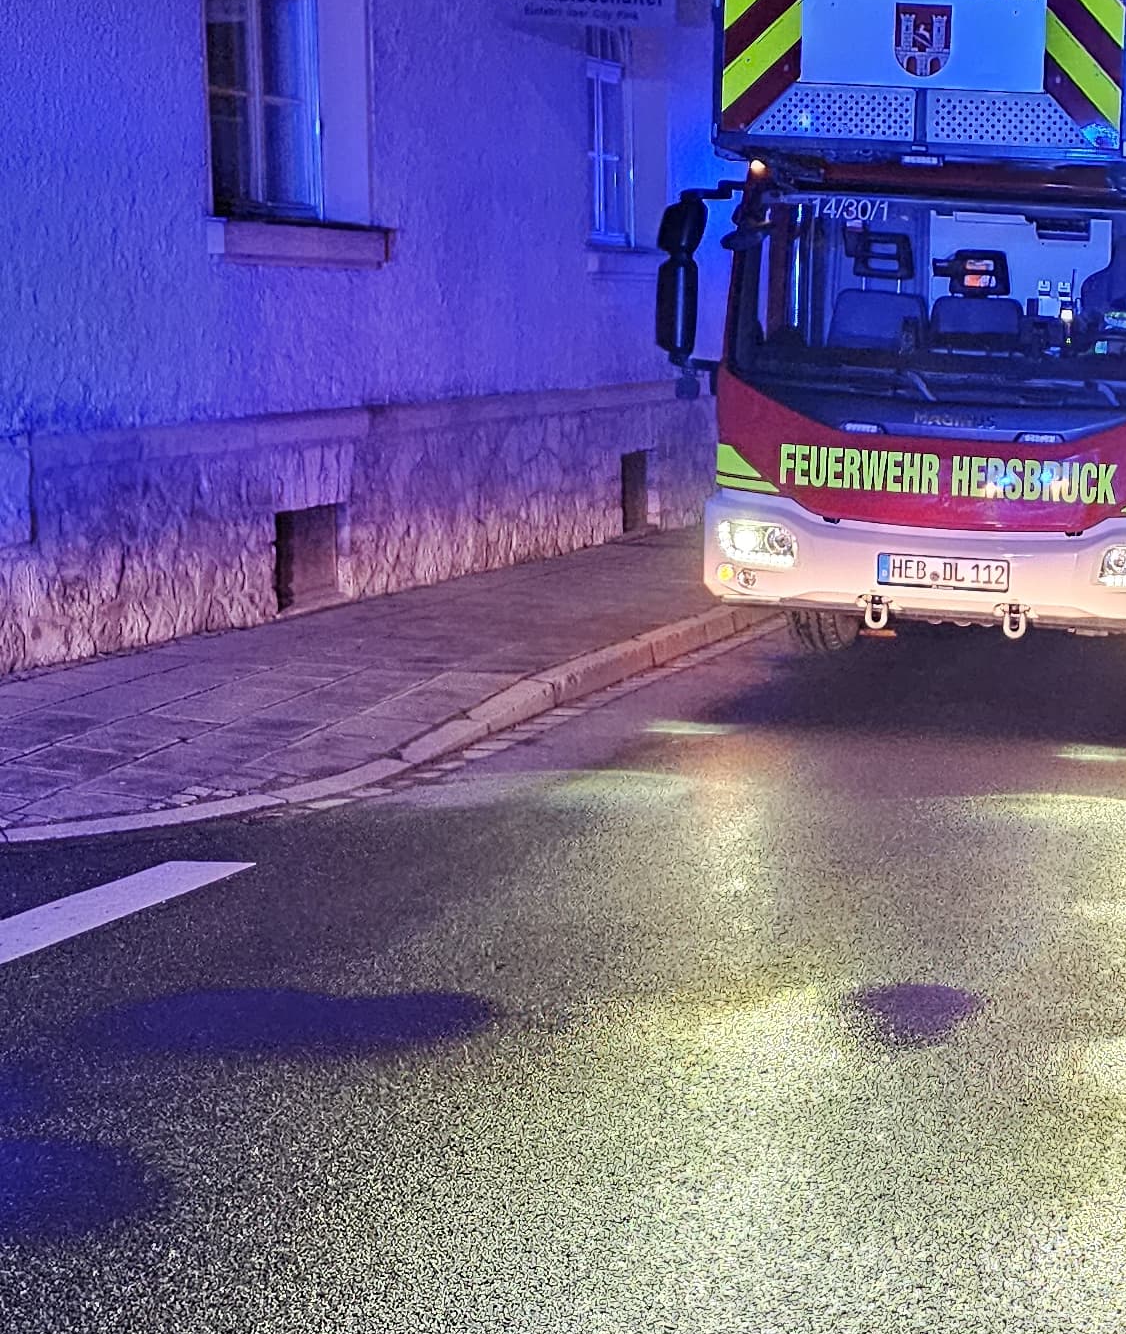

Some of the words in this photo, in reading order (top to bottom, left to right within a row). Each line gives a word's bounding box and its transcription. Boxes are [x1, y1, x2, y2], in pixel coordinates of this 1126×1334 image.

[812, 197, 889, 222] 14/30/1
[779, 443, 940, 494] FEUERWEHR
[951, 455, 1118, 505] HERSBRUCK
[891, 558, 927, 580] HEB
[942, 561, 965, 582] DL
[970, 563, 1005, 585] 112
